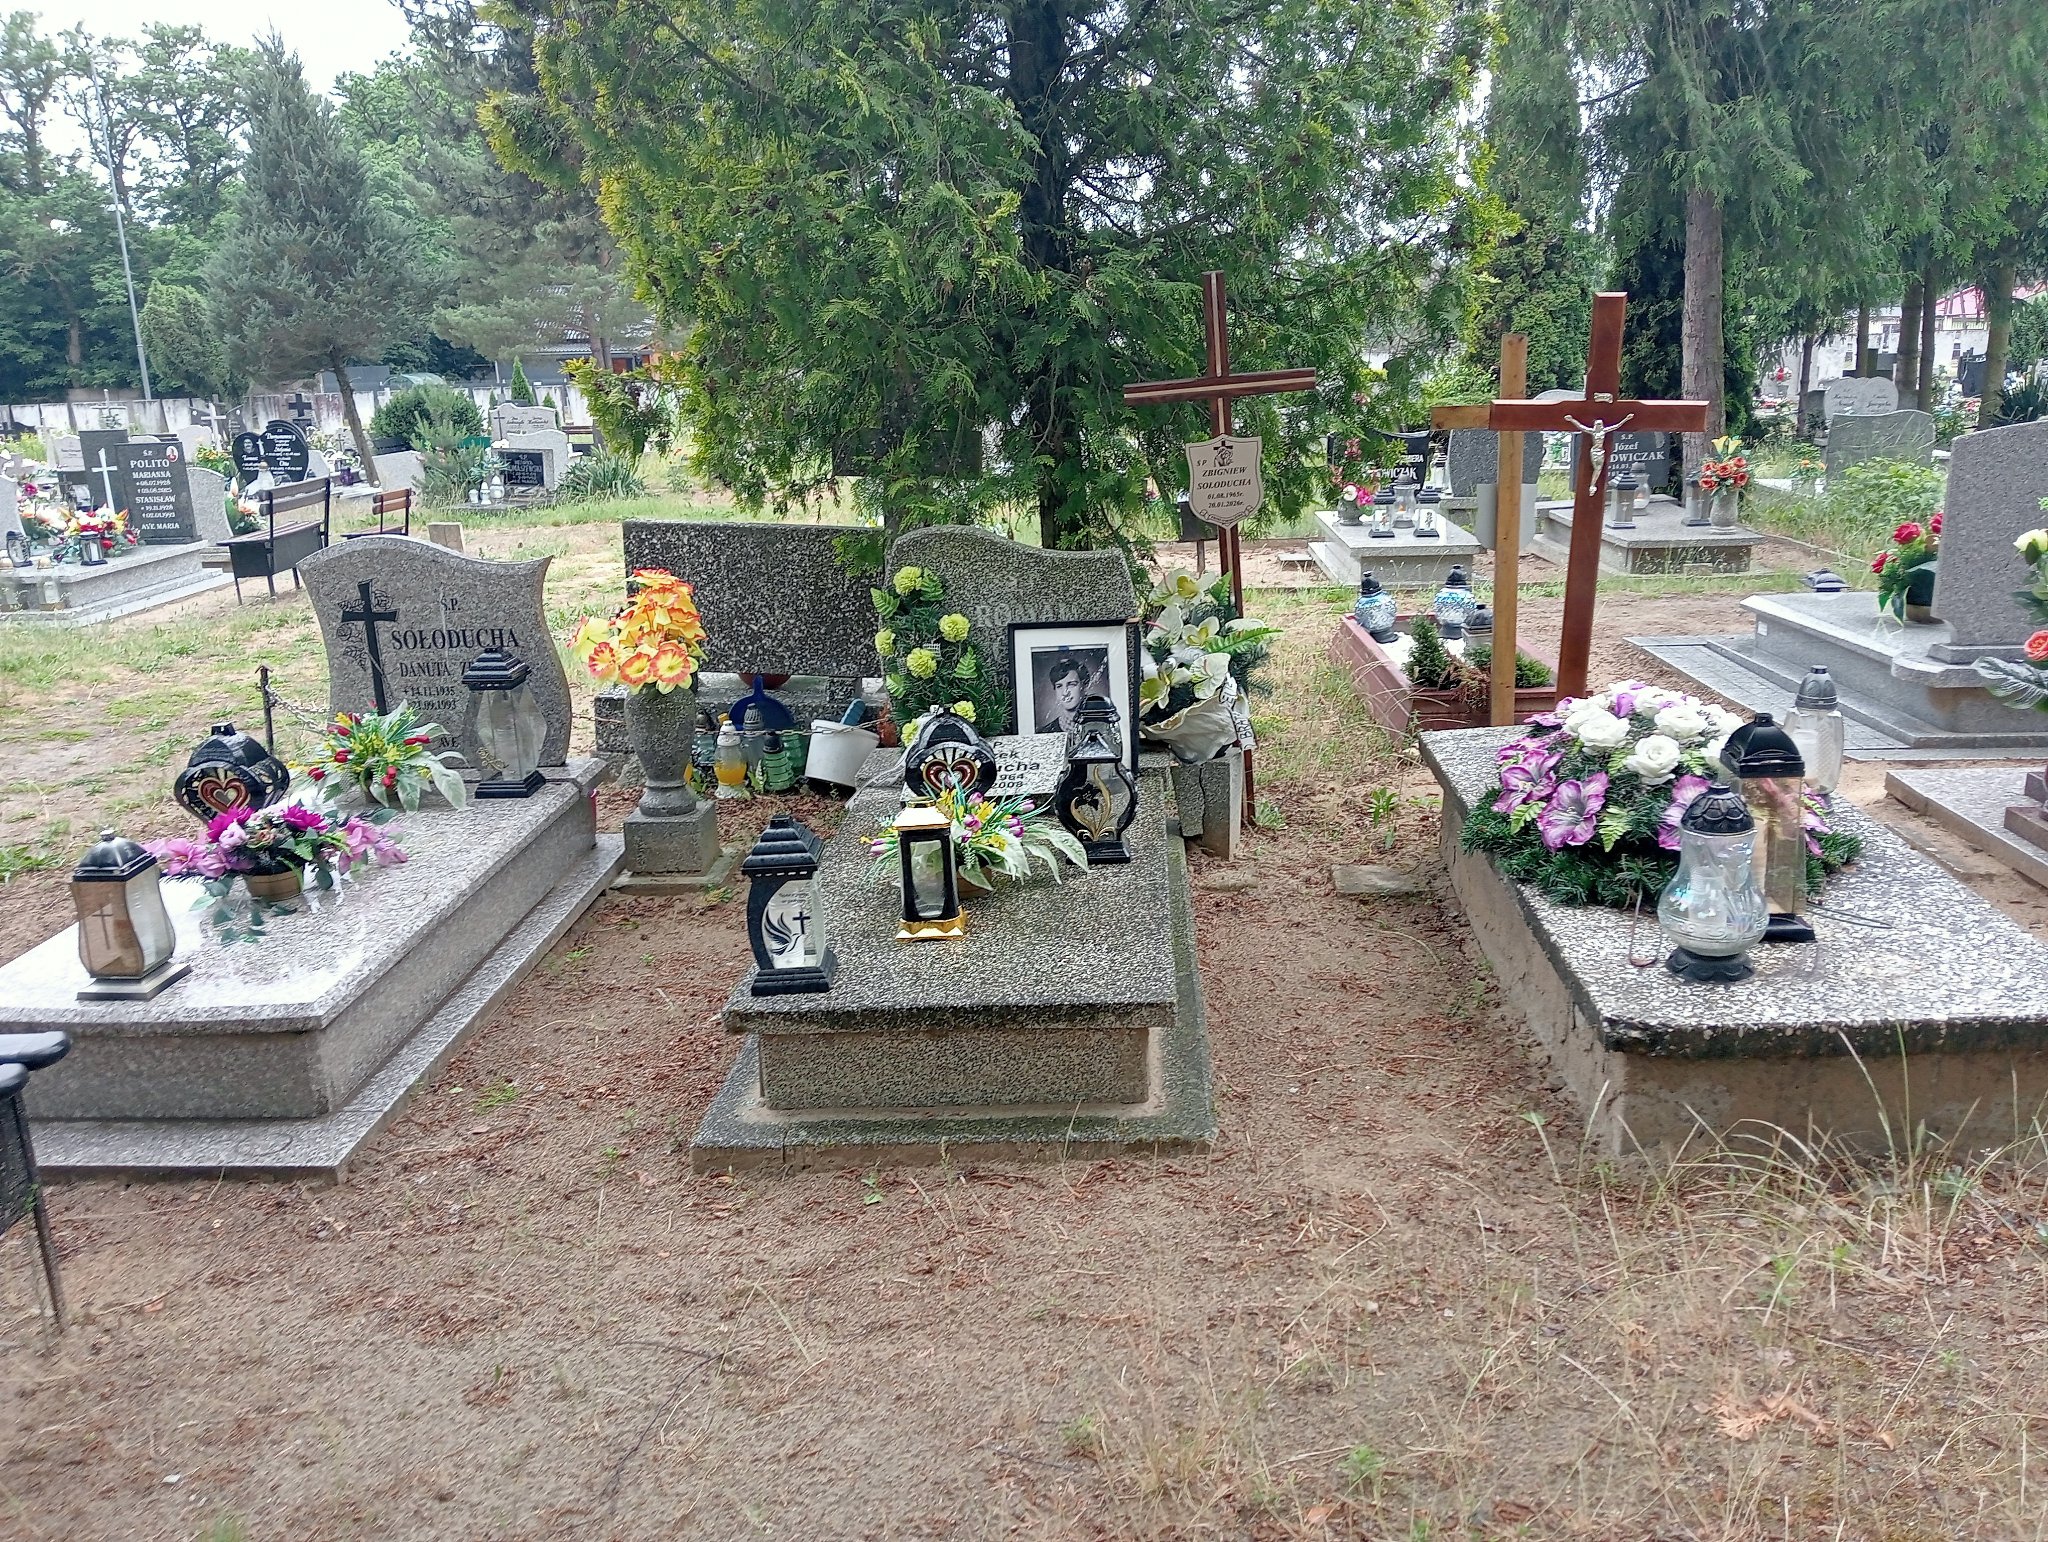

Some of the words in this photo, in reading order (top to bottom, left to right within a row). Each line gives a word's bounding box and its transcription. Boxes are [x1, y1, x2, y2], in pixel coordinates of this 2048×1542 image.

[1613, 441, 1639, 453] Józef
[130, 459, 170, 469] POLITO
[132, 471, 172, 479] MARIANNA
[1202, 466, 1248, 477] ZBIGNIEW
[156, 522, 180, 530] MARIA
[391, 628, 519, 650] SOŁODUCHA
[400, 661, 452, 678] DANUTA
